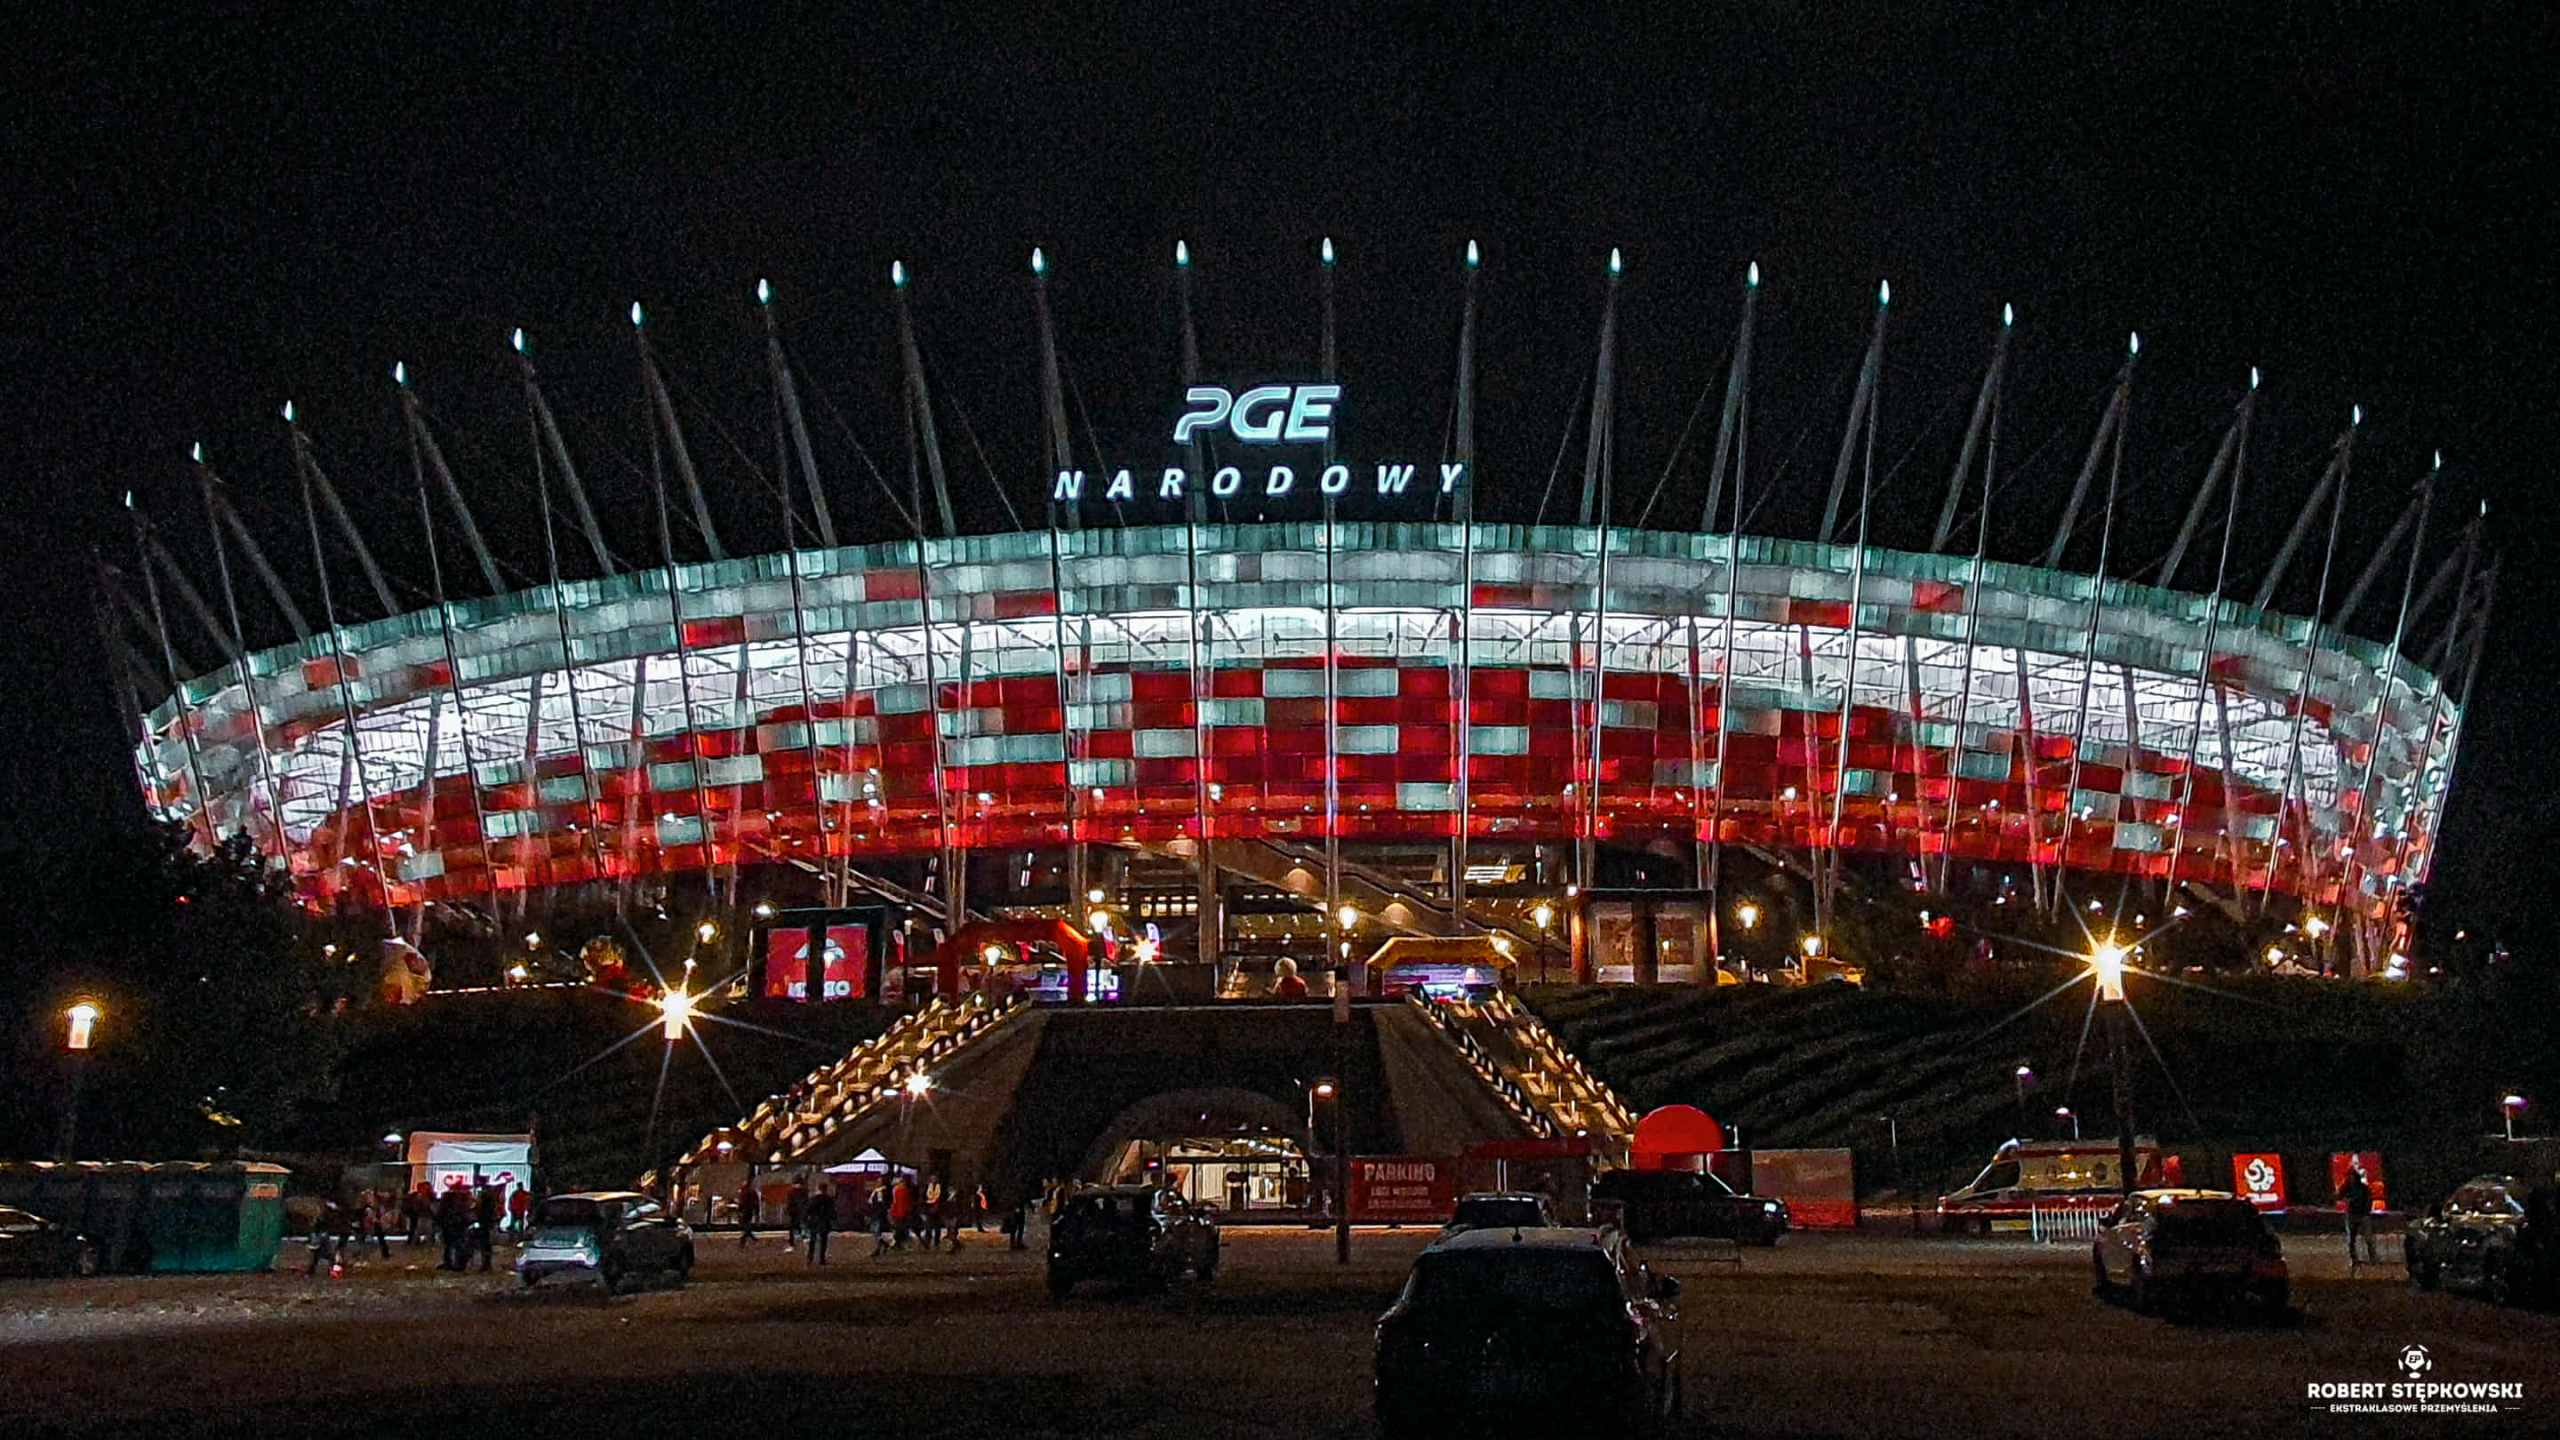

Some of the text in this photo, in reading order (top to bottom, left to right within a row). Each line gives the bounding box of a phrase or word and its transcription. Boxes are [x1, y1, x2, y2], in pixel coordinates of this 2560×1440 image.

[1173, 385, 1341, 443] PGE
[1053, 463, 1464, 500] NARODOWY
[1364, 1163, 1435, 1181] PARKING
